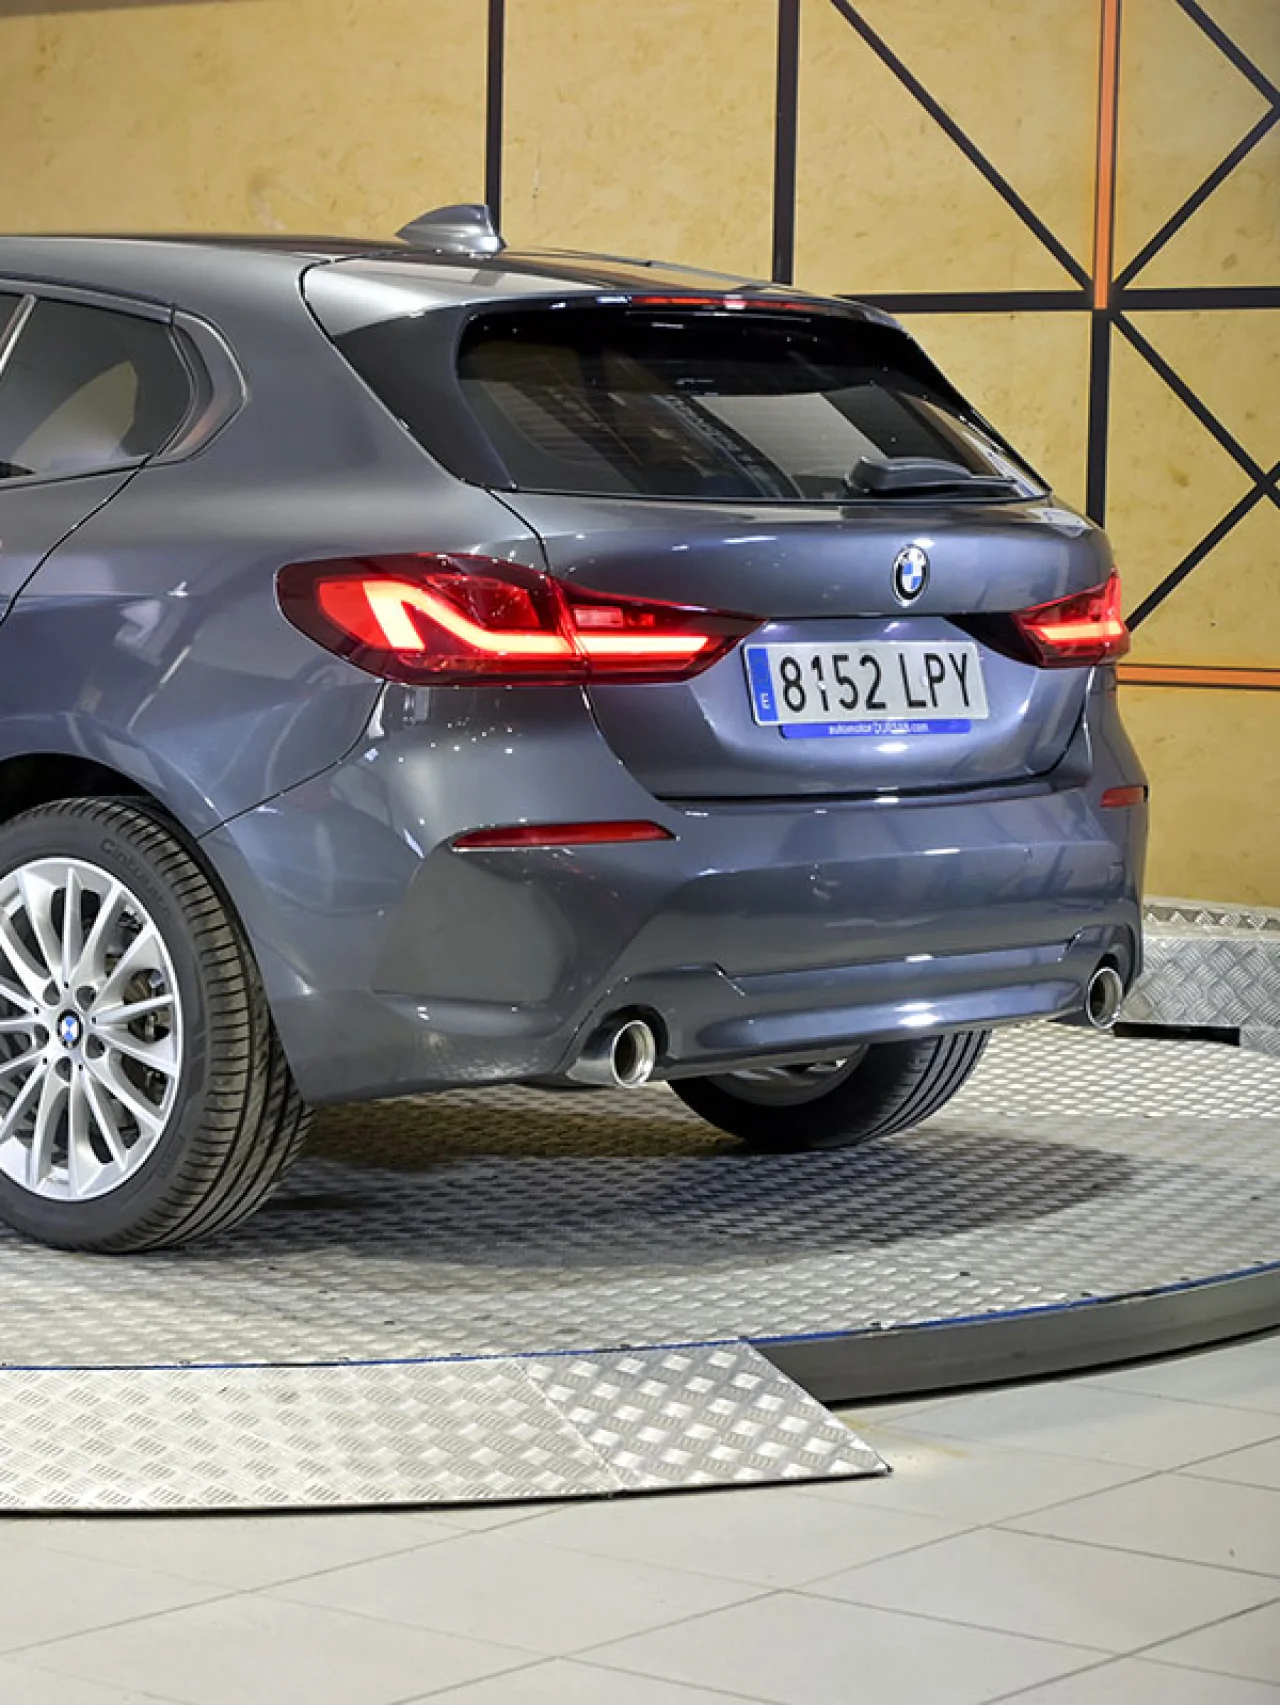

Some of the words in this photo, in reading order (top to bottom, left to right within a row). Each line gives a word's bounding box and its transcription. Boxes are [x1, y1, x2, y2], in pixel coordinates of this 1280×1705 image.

[759, 692, 771, 710] E
[780, 653, 887, 713] 8152
[897, 652, 970, 709] LPY
